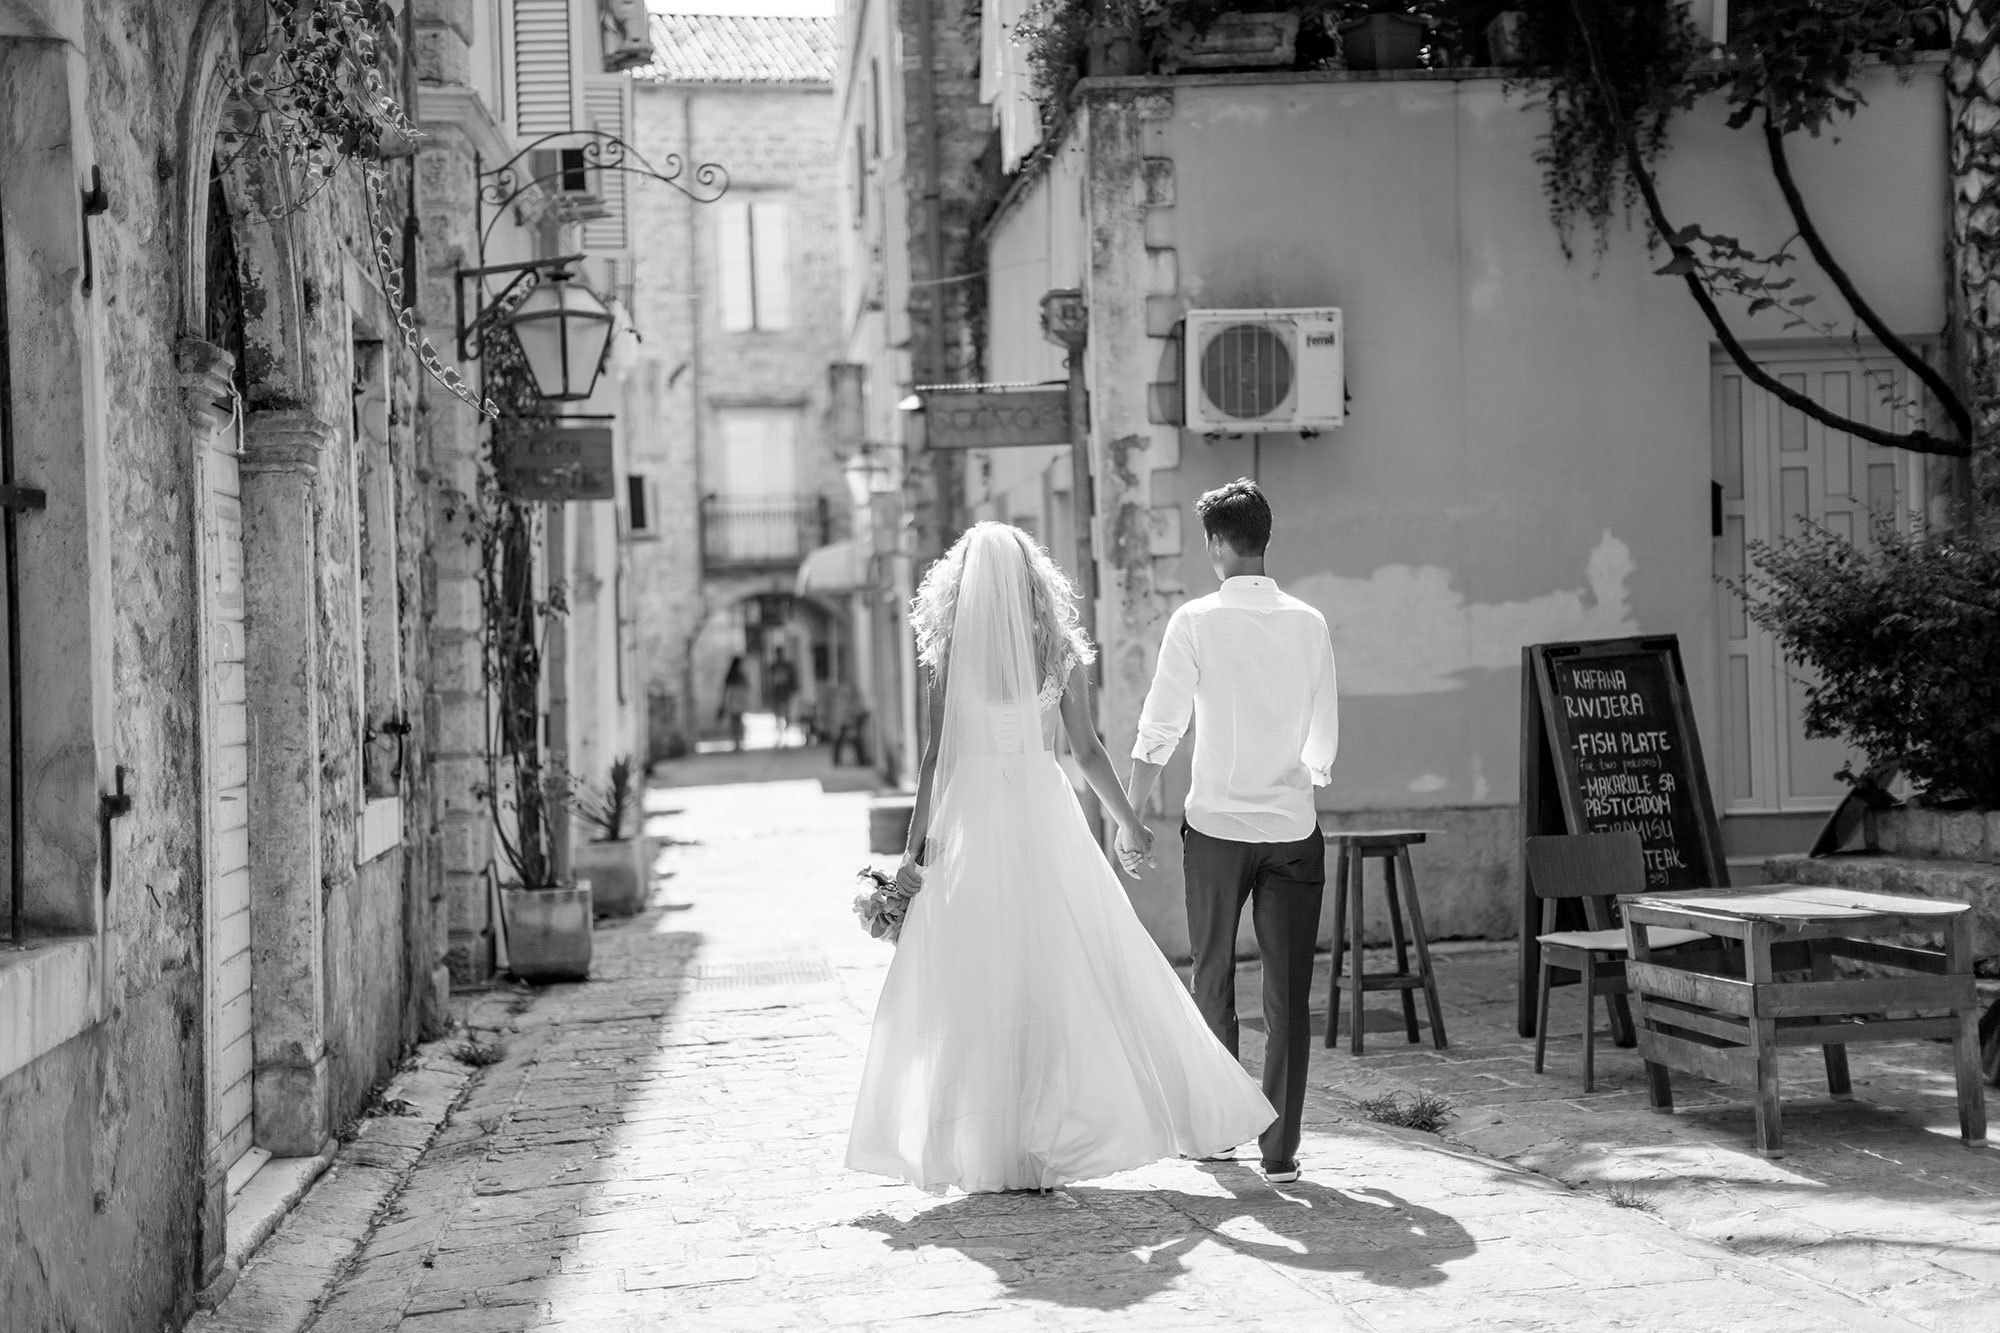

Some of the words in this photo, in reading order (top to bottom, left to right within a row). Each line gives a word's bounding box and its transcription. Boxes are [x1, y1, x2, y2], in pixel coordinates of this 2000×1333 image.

[1572, 669, 1627, 691] KAFANA
[1563, 692, 1645, 719] RIVIJERA
[1621, 731, 1672, 754] PLATE
[1659, 772, 1676, 792] SA
[1643, 847, 1688, 870] TEAK
